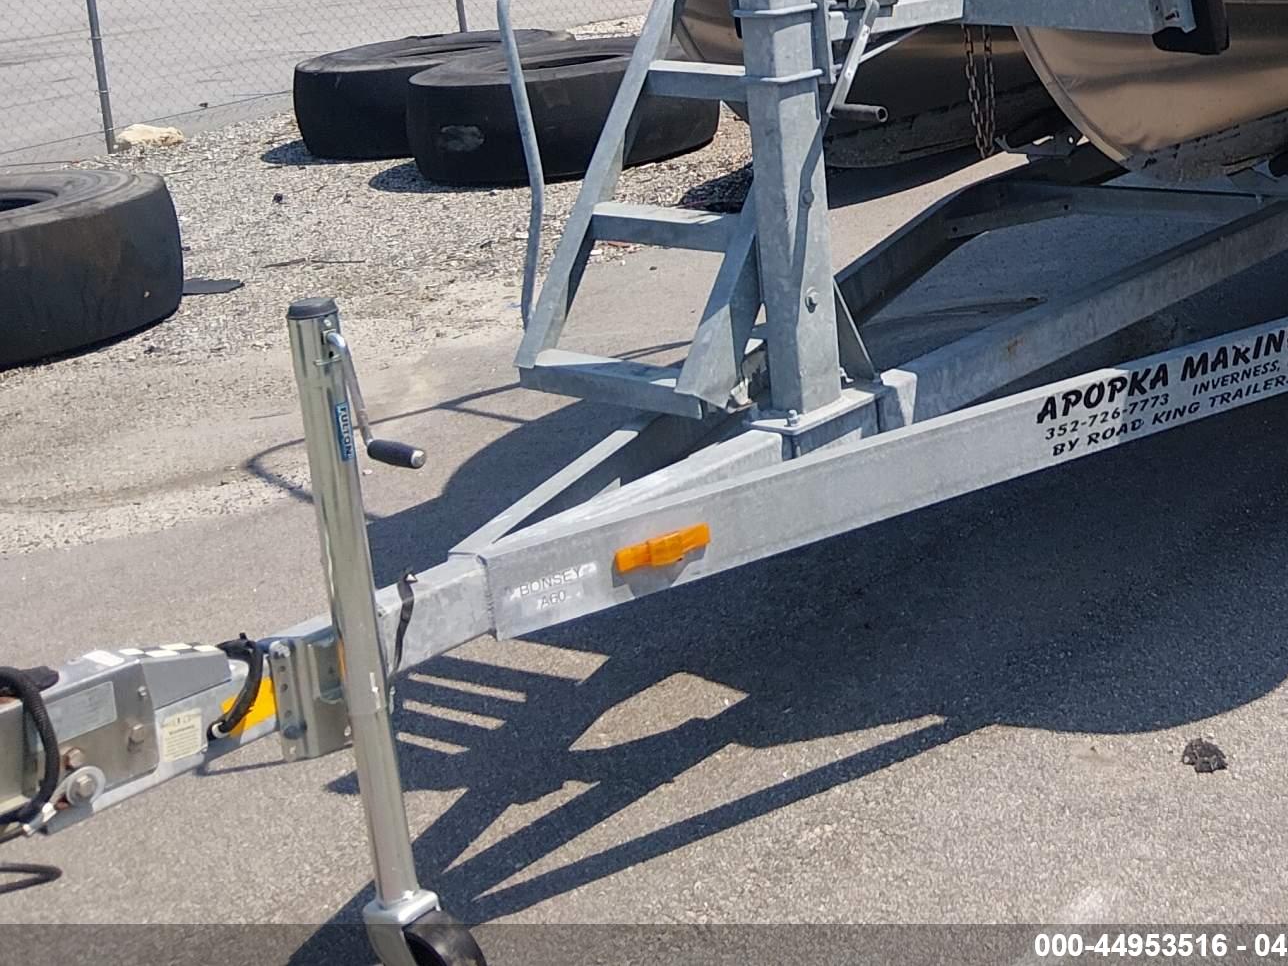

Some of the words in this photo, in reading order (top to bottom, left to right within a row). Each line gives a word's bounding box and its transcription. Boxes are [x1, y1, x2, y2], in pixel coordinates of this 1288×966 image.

[1036, 363, 1169, 424] APOPKA
[1045, 393, 1170, 441] 352-726-7773
[1192, 360, 1281, 397] INVERNESS,
[1052, 437, 1080, 456] BY
[1087, 418, 1145, 445] ROAD
[1152, 401, 1201, 426] KING
